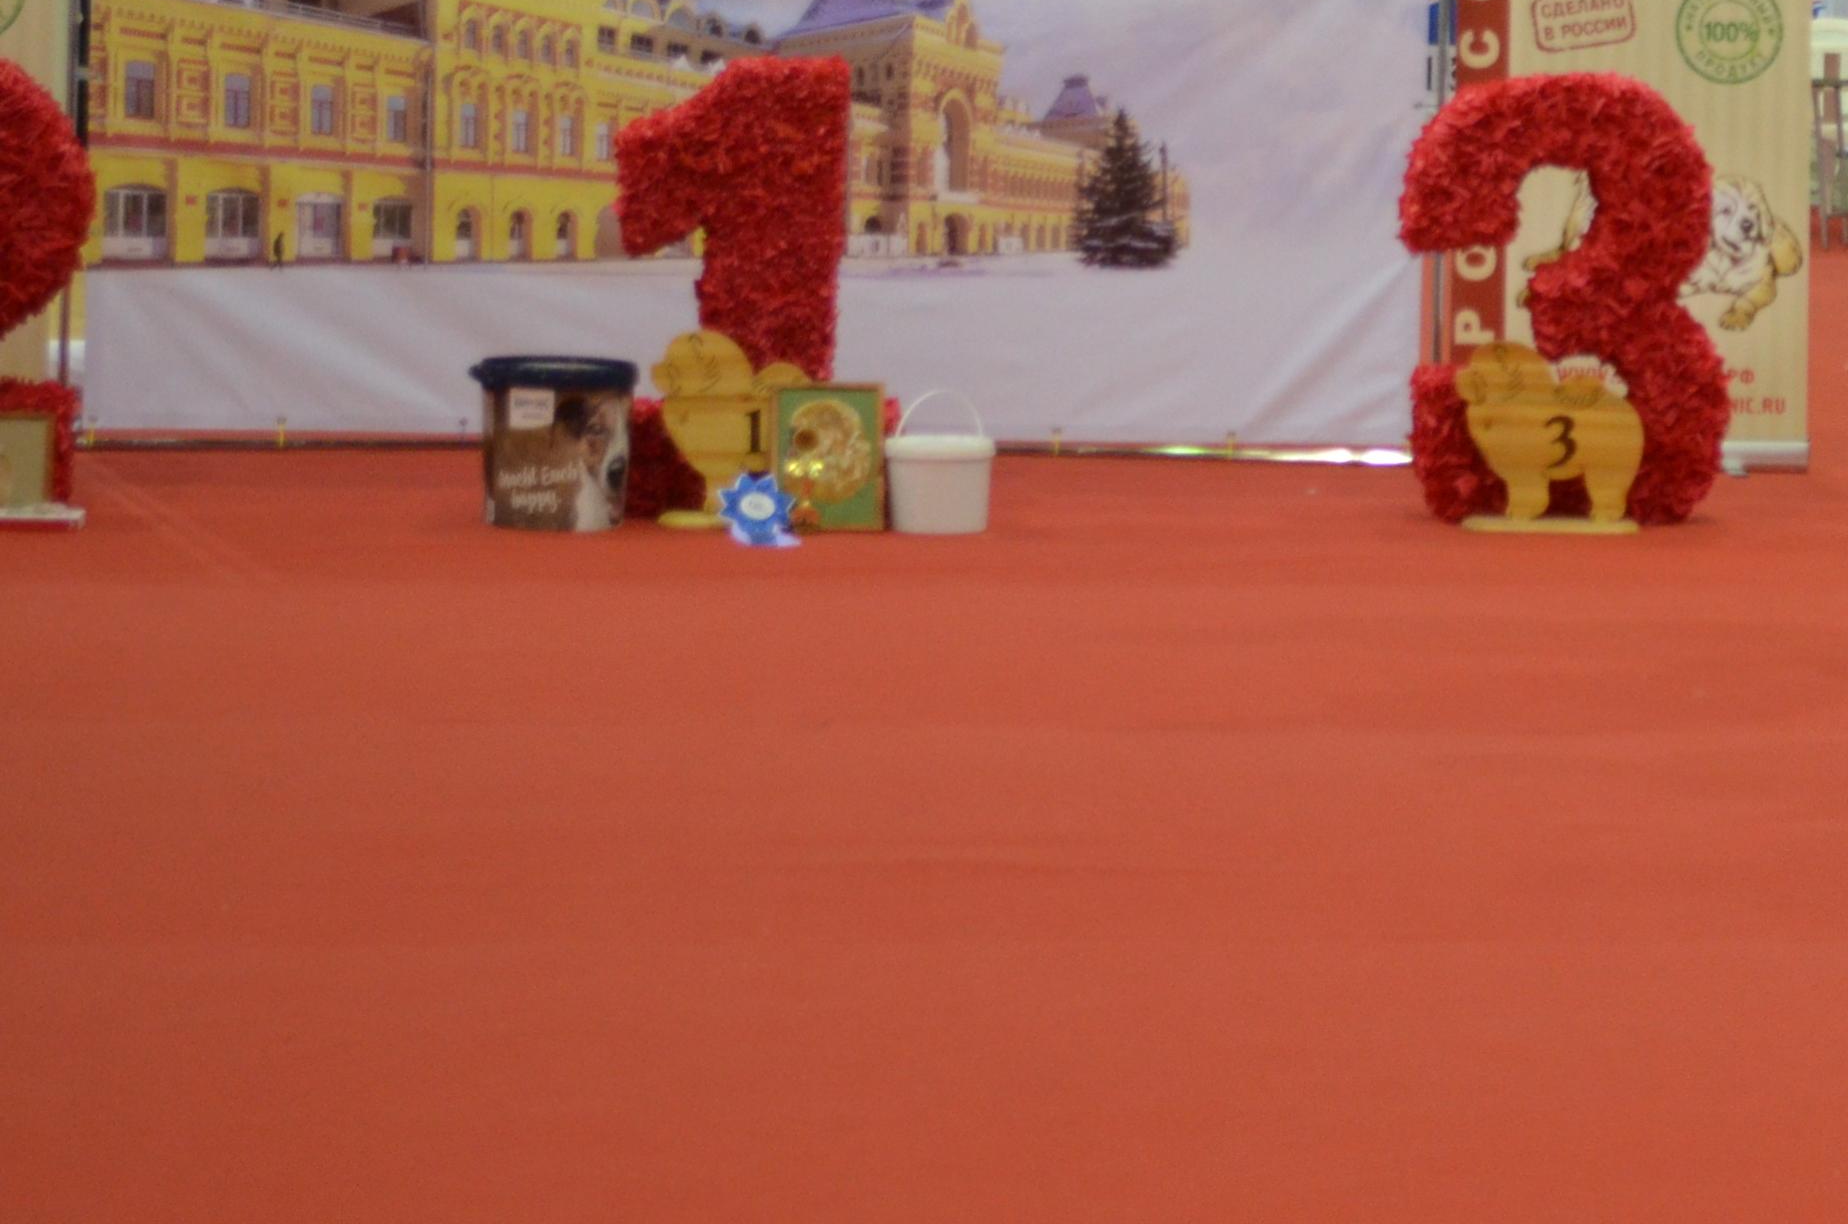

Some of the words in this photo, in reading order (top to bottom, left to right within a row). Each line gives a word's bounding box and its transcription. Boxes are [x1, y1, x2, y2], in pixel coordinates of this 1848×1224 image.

[1543, 26, 1555, 42] В
[1561, 15, 1628, 40] РОССИИ
[1703, 21, 1759, 44] 100%
[1544, 415, 1578, 469] 3
